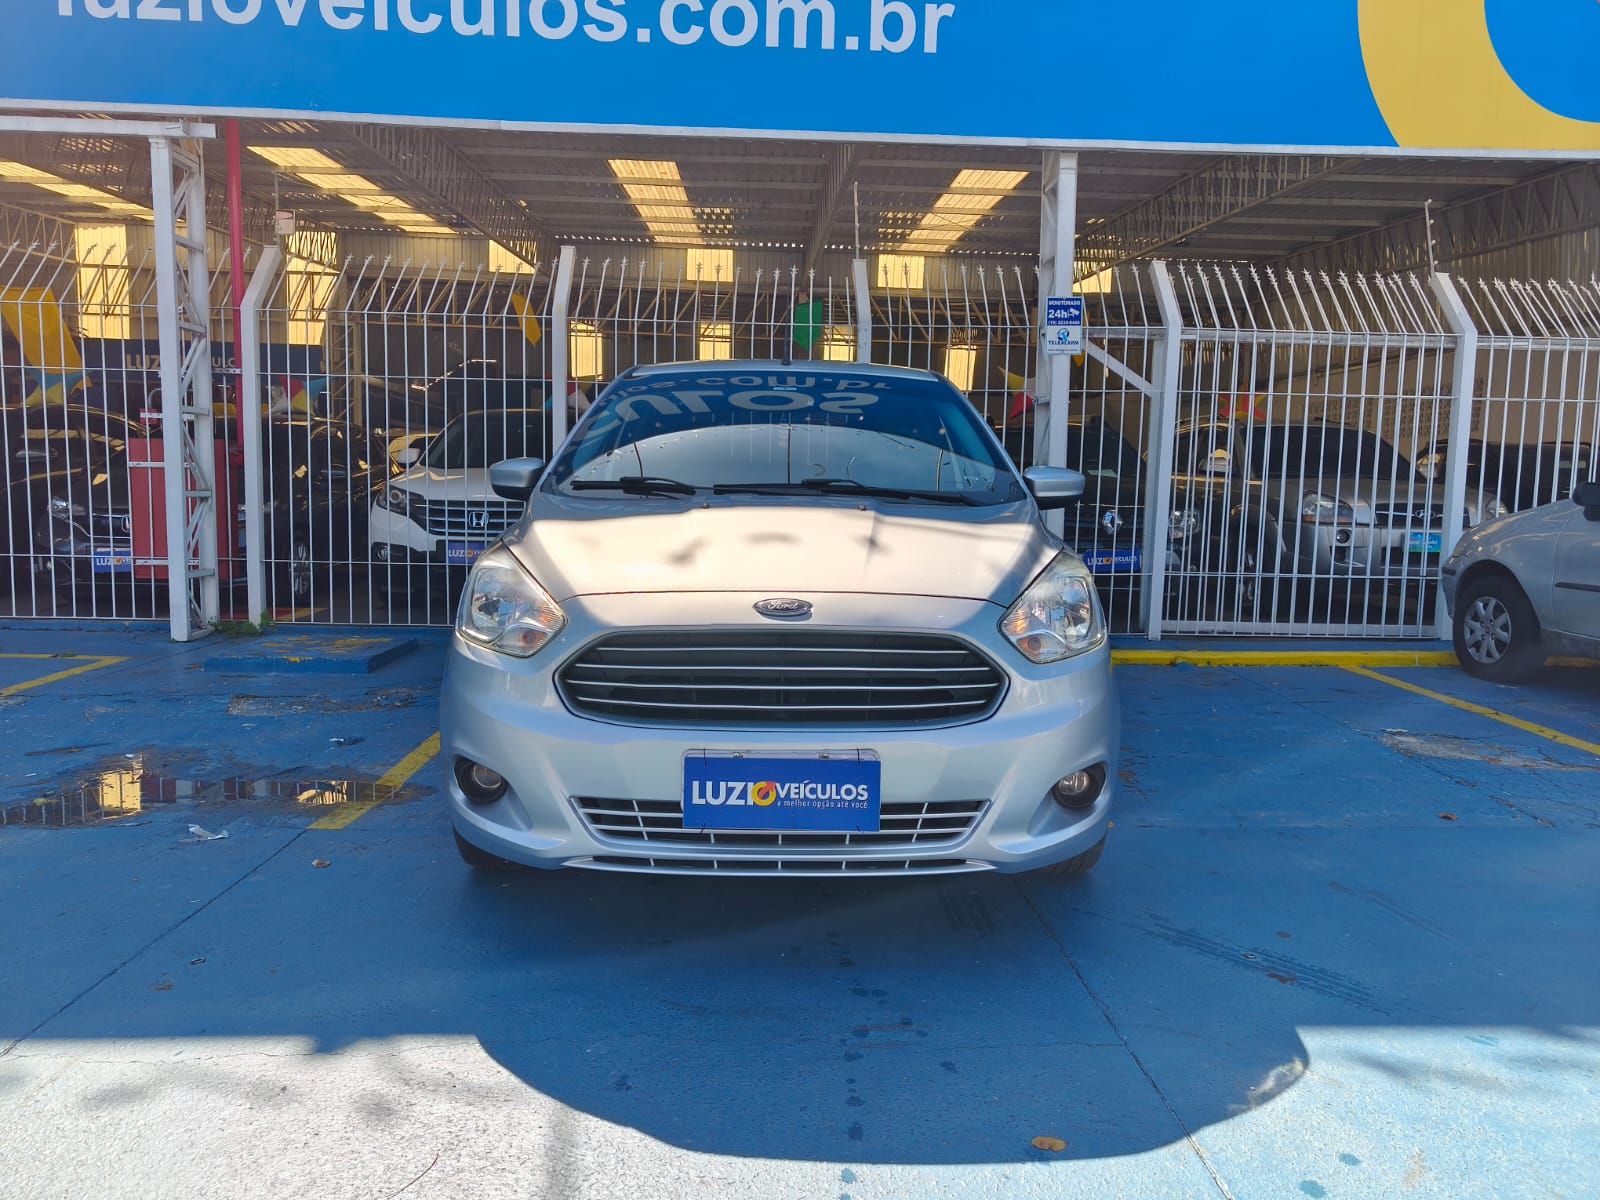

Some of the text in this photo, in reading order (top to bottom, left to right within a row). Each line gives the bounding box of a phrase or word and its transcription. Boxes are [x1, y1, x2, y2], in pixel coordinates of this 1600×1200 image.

[58, 0, 956, 54] veculos.com.br
[1048, 309, 1068, 319] 24h
[126, 353, 161, 370] LUZ
[767, 601, 799, 610] Ford
[692, 779, 869, 807] LUZIO VEÍCULOS
[783, 799, 810, 807] melhor
[812, 800, 835, 809] opção
[836, 800, 849, 808] até
[851, 801, 868, 809] você
